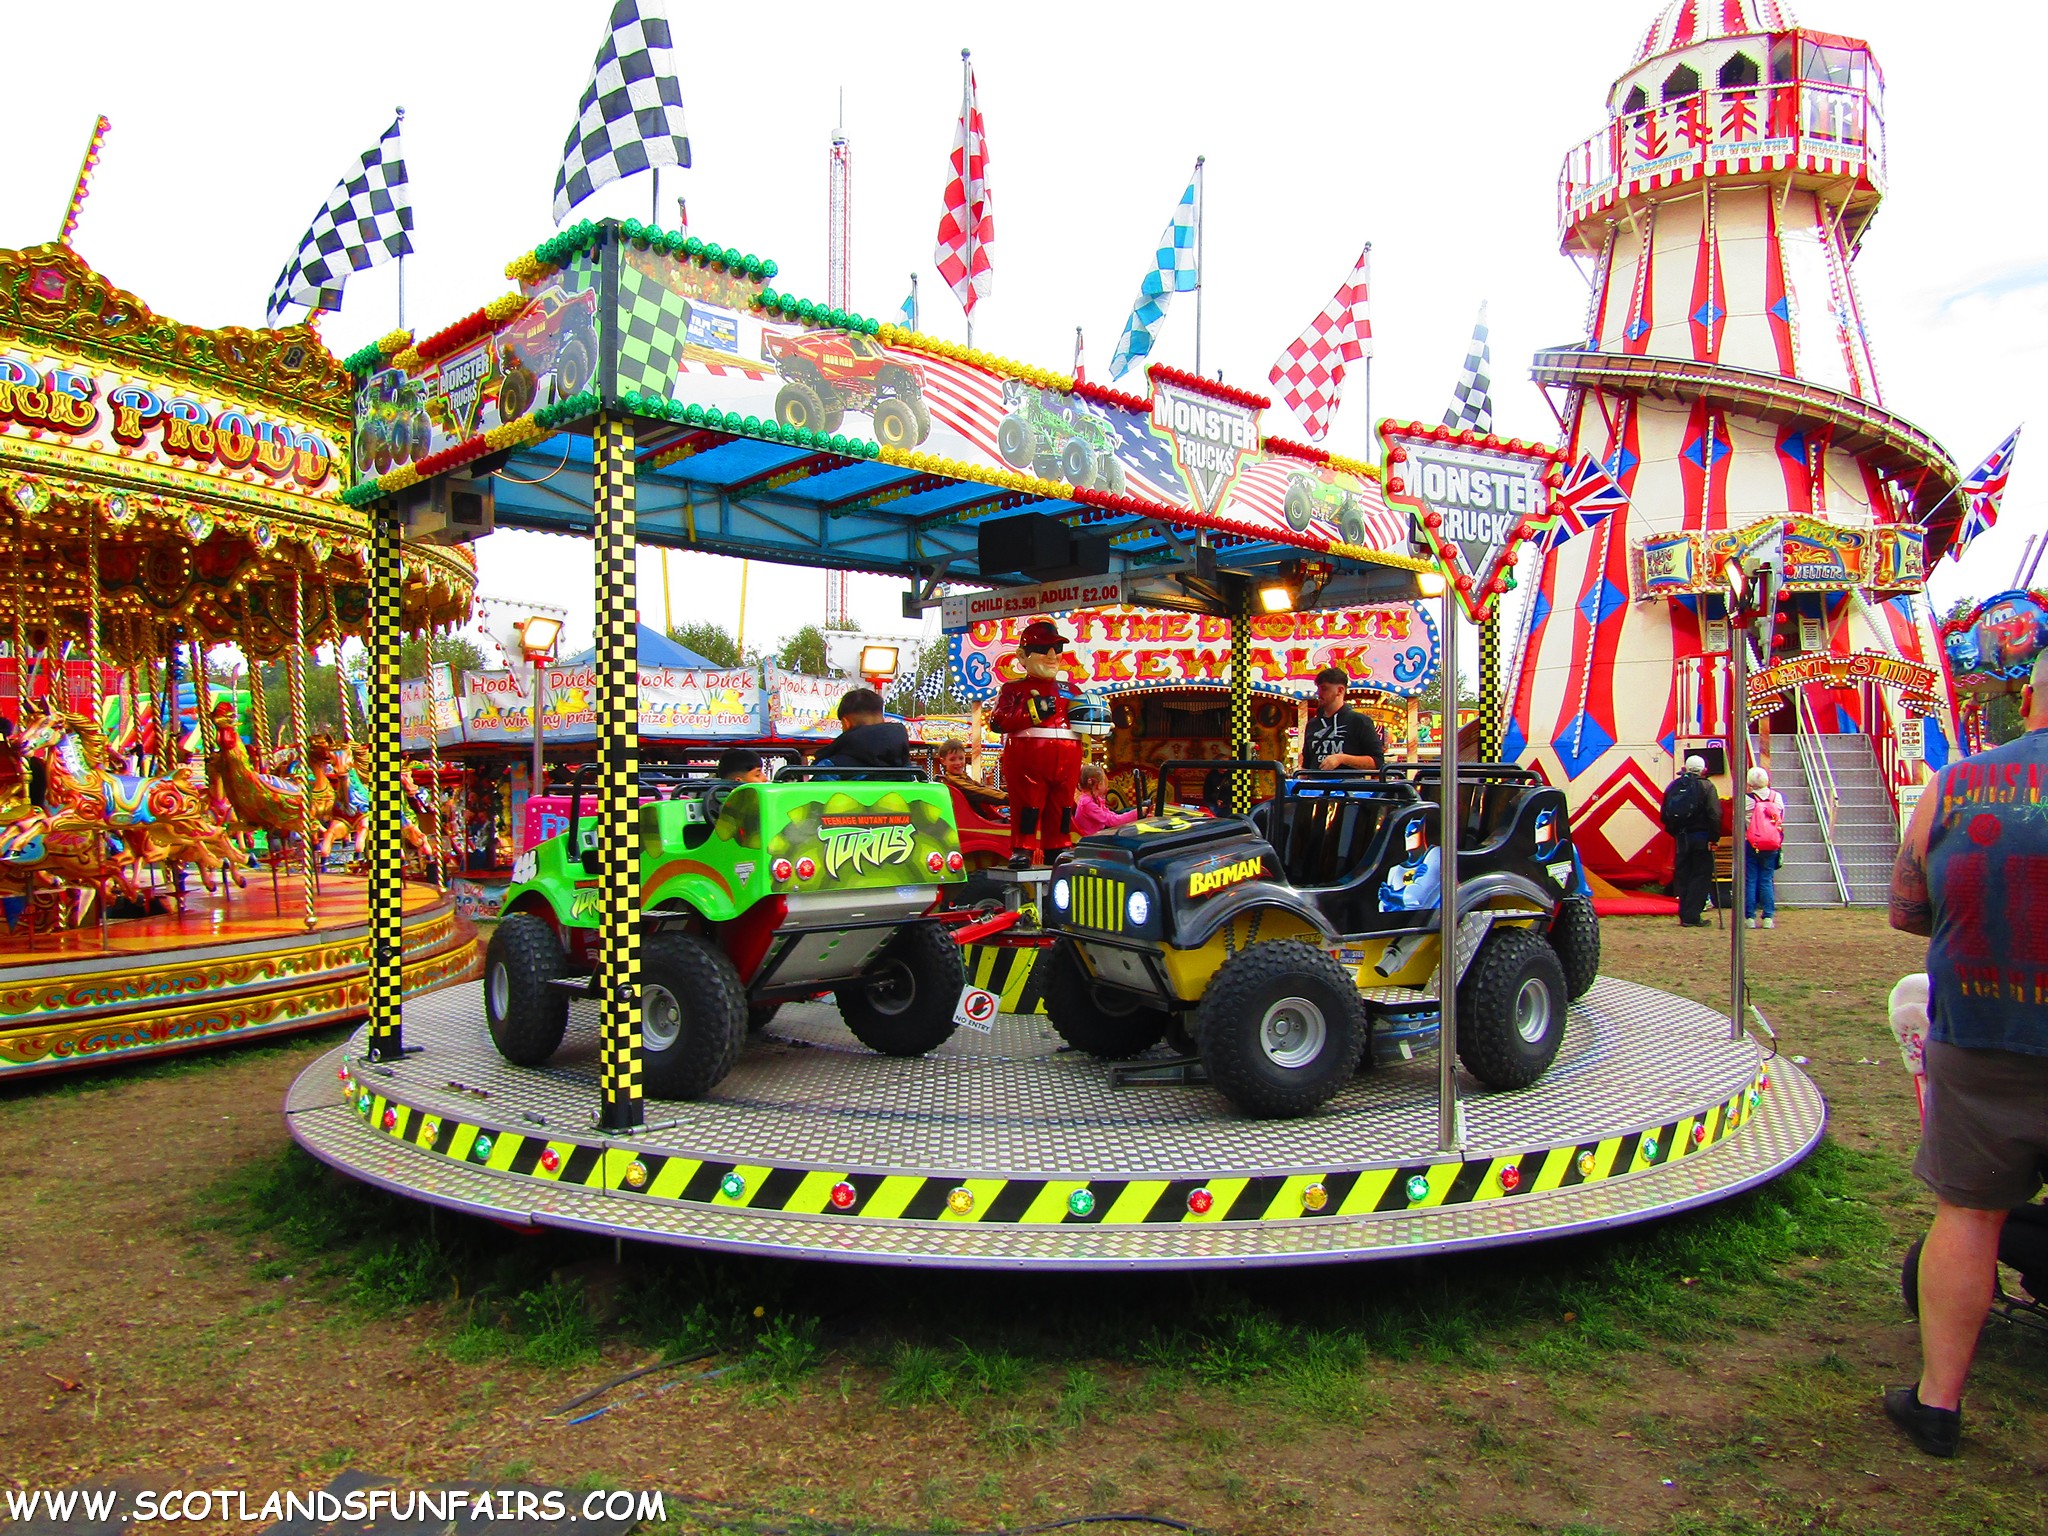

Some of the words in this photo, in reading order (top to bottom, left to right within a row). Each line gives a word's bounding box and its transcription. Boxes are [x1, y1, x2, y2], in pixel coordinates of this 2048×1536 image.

[1711, 144, 1726, 157] BY
[1630, 151, 1693, 177] PRESENTED
[440, 353, 490, 396] MONSTER
[450, 385, 478, 411] TRUCKS
[108, 384, 331, 488] PROUD
[1154, 394, 1258, 452] MONSTER
[1177, 434, 1235, 477] TRUCKS
[1393, 462, 1547, 515] MONSTER
[1788, 565, 1843, 580] KELTER
[971, 598, 1003, 614] CHILD
[1005, 597, 1036, 611] £3.50
[1041, 587, 1078, 604] ADULT
[1082, 585, 1118, 602] £2.00
[1068, 610, 1193, 643] TYME
[1198, 608, 1412, 642] BOOKLYN
[471, 675, 519, 694] Hook
[550, 668, 596, 689] Duck
[638, 669, 674, 688] ook
[682, 672, 697, 687] A
[706, 671, 753, 689] Duck
[779, 676, 807, 694] Hook
[811, 681, 820, 696] A
[1751, 658, 1828, 693] GIANT
[1851, 656, 1931, 690] SLIDE
[473, 717, 497, 730] one
[503, 714, 529, 728] win
[541, 715, 561, 733] ny
[672, 713, 711, 729] every
[717, 712, 749, 725] time
[822, 816, 857, 825] TEENAGE
[858, 816, 888, 825] MUTANT
[889, 816, 910, 824] NINJA
[818, 824, 916, 879] TURTLES
[1189, 856, 1261, 897] BATMAN
[955, 1015, 967, 1023] NO
[968, 1020, 990, 1032] ENTRY
